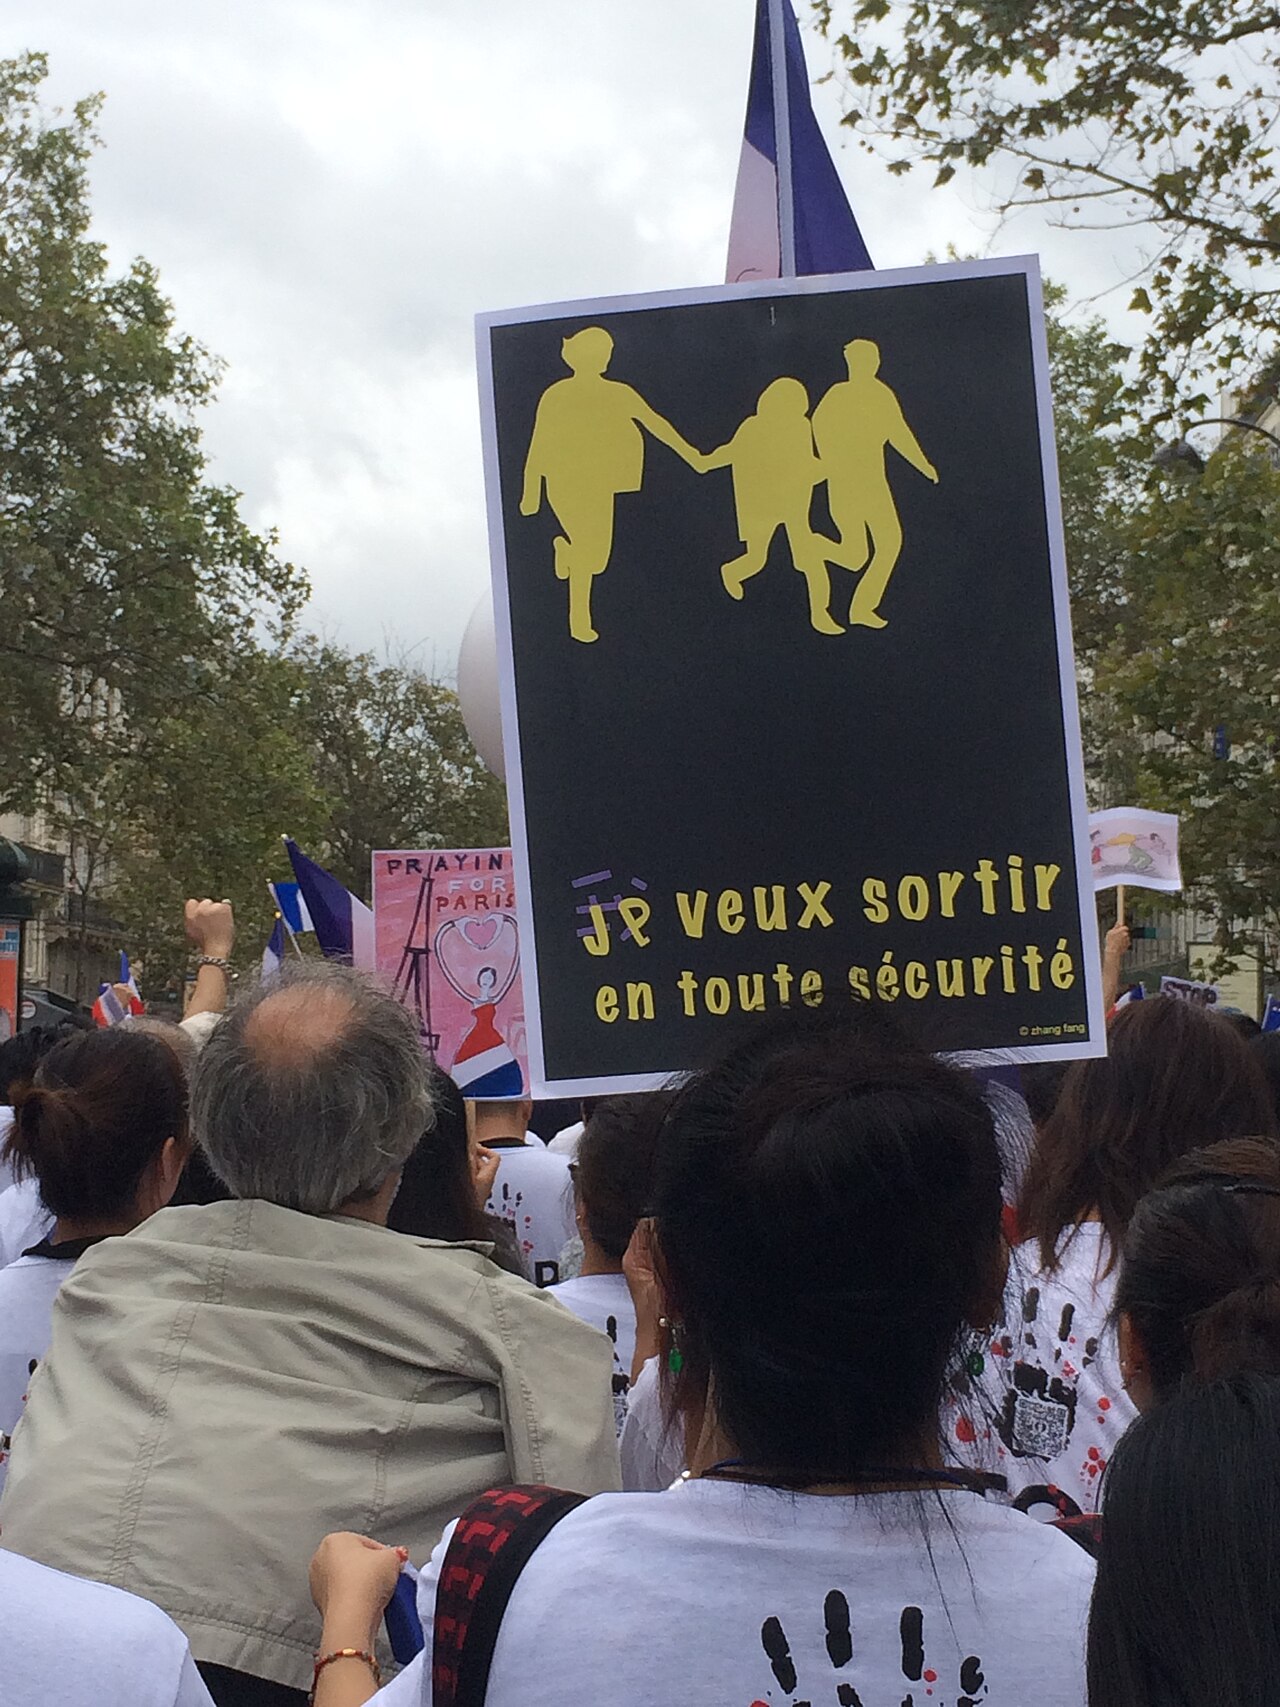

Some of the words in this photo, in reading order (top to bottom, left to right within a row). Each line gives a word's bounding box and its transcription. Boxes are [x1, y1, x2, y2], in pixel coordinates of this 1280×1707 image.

[387, 854, 513, 875] PRAYIN
[448, 877, 506, 894] FOR
[435, 894, 514, 912] PARIS
[676, 881, 834, 938] veux
[863, 855, 1060, 923] sortir
[596, 983, 654, 1023] en
[677, 964, 825, 1016] toute
[849, 938, 1075, 1001] sécurité
[1031, 1025, 1062, 1036] zhang
[1063, 1023, 1085, 1034] fang
